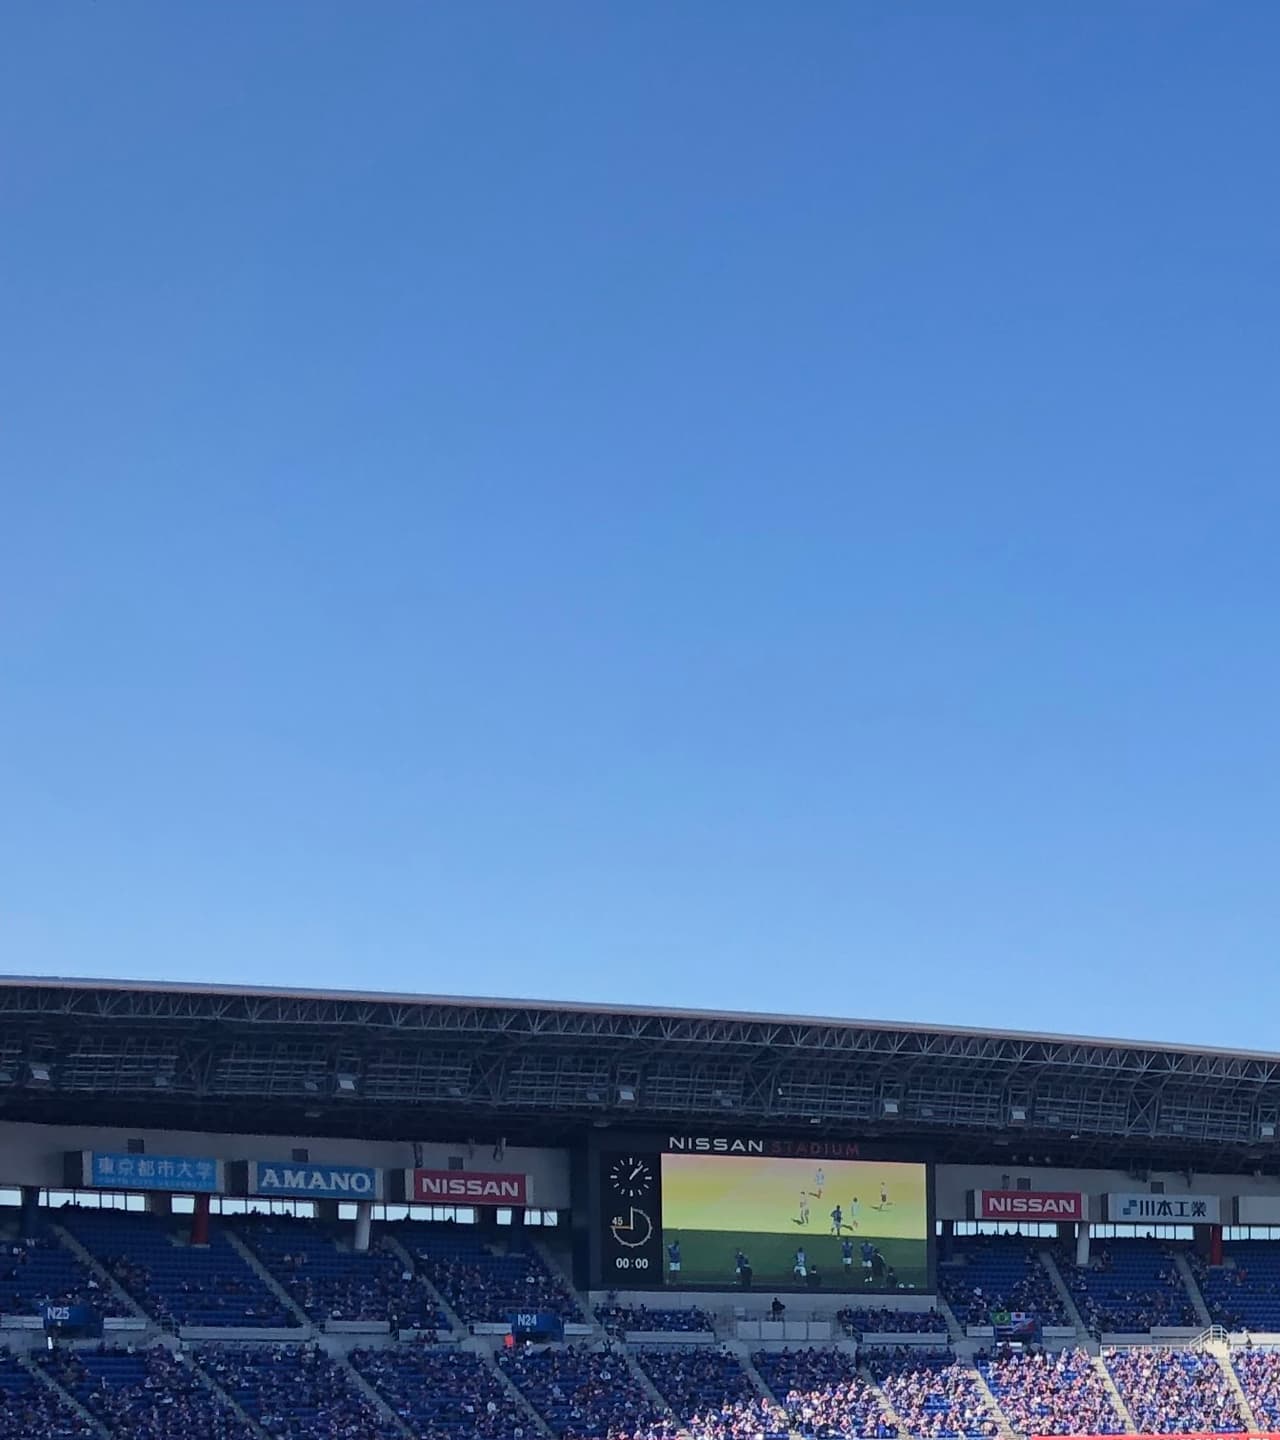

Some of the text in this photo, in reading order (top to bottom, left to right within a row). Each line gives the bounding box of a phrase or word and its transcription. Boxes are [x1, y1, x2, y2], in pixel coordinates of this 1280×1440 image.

[669, 1136, 859, 1157] NISSAN STADIUM
[98, 1157, 213, 1181] 東京都市大学
[261, 1168, 371, 1192] AMANO
[421, 1177, 519, 1197] NISSAN
[988, 1197, 1075, 1213] NISSAN
[612, 1216, 624, 1226] 45
[616, 1257, 649, 1270] 00:00
[47, 1306, 70, 1320] N25
[517, 1314, 537, 1327] N24
